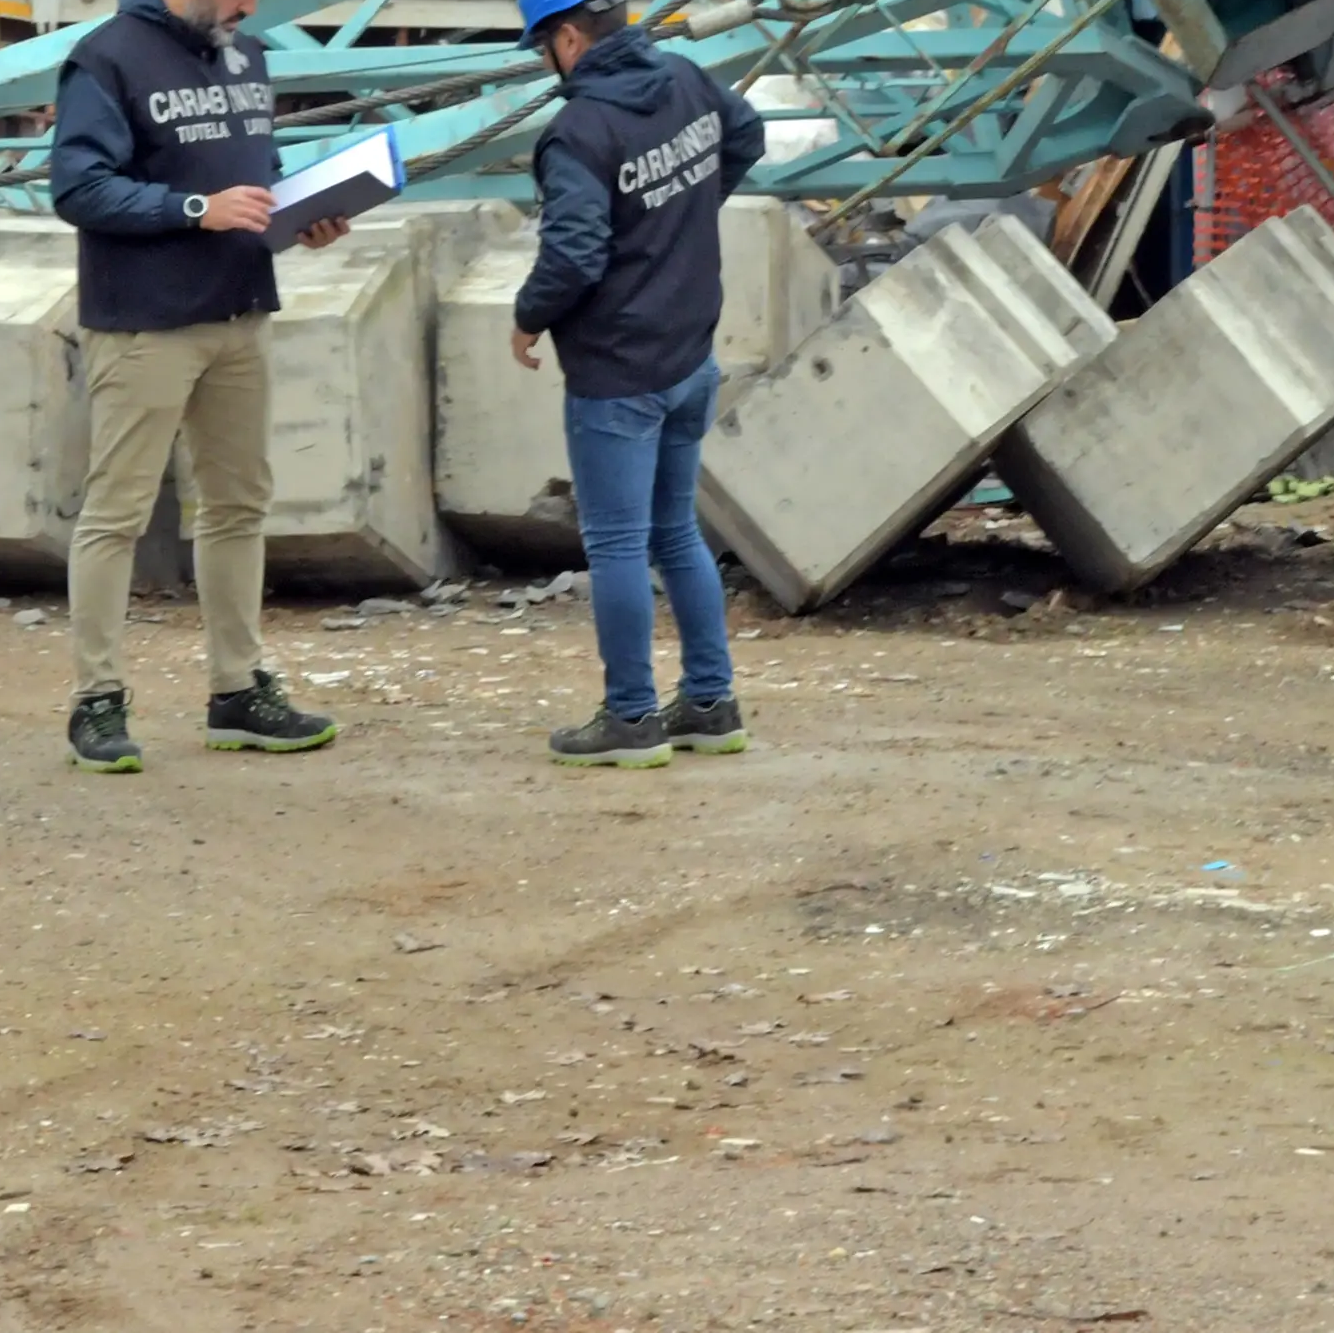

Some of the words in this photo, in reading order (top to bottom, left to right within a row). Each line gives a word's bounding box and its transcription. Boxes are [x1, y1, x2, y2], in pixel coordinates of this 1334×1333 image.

[149, 82, 274, 124] CARABNIE
[175, 121, 232, 144] TUTELA
[618, 111, 722, 195] CARANIE
[642, 175, 685, 210] TUTA
